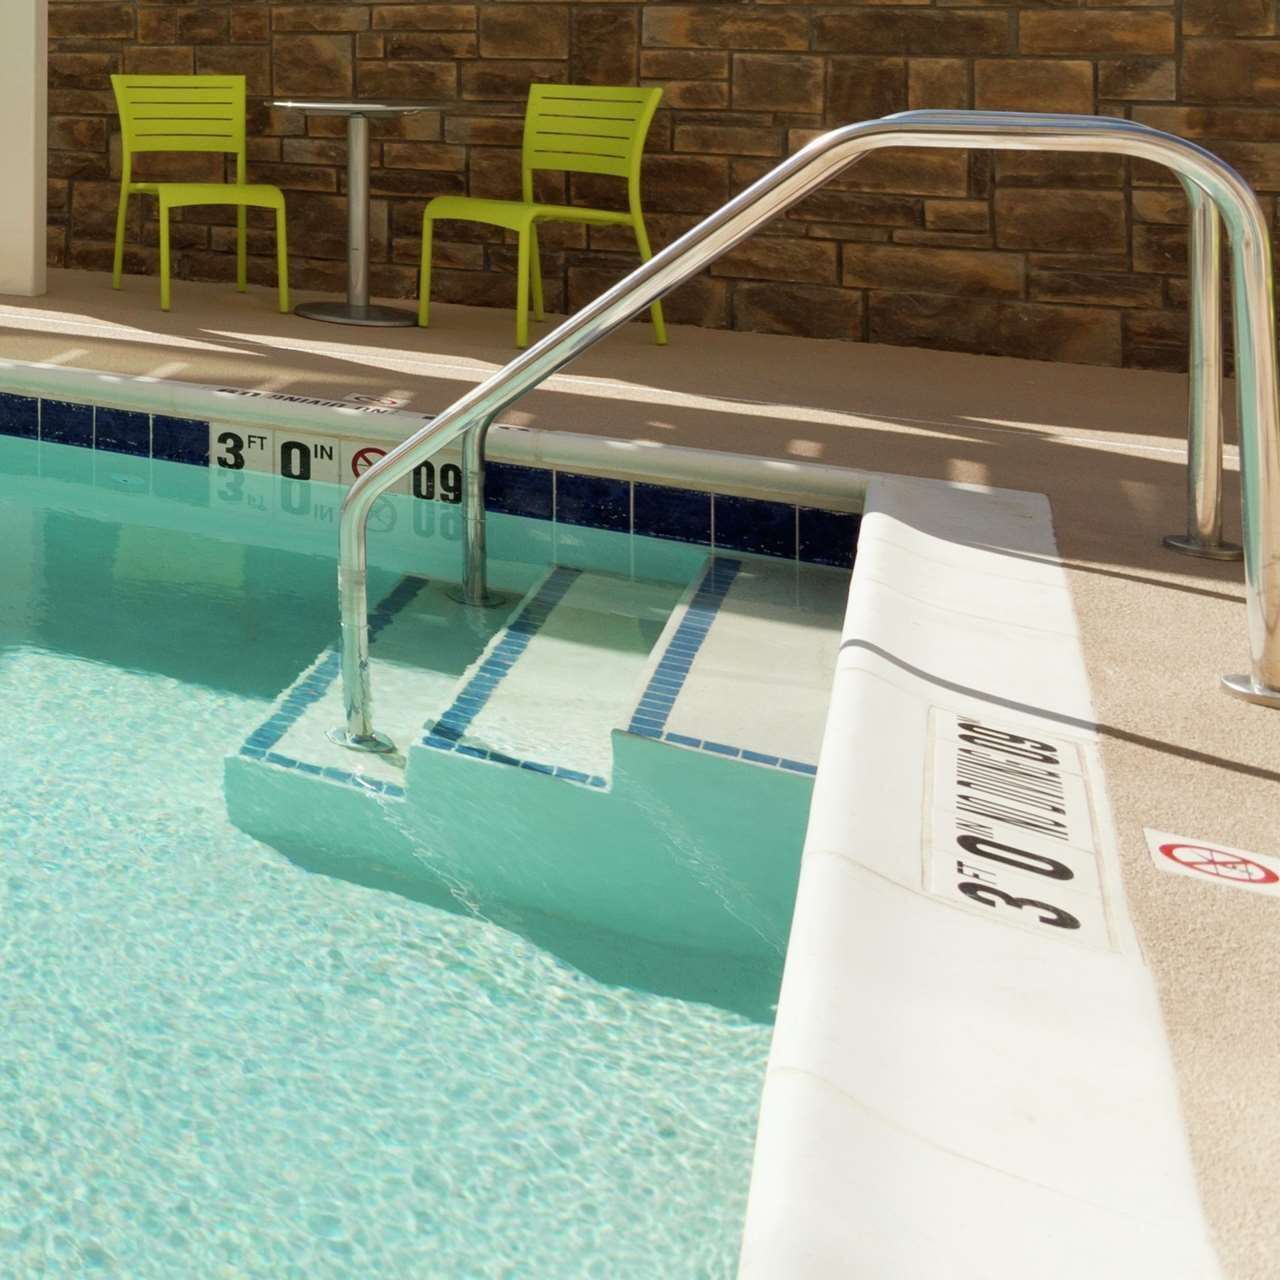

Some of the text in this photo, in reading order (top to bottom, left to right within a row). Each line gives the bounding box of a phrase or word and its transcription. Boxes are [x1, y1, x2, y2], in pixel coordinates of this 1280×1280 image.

[217, 431, 245, 470] 3
[248, 434, 267, 451] FT
[280, 440, 311, 481] 0
[314, 443, 333, 461] IN
[956, 748, 1067, 816] DIVING
[956, 794, 1070, 841] NO
[956, 835, 1075, 881] 0
[956, 860, 997, 885] FT
[957, 881, 1081, 930] 3
